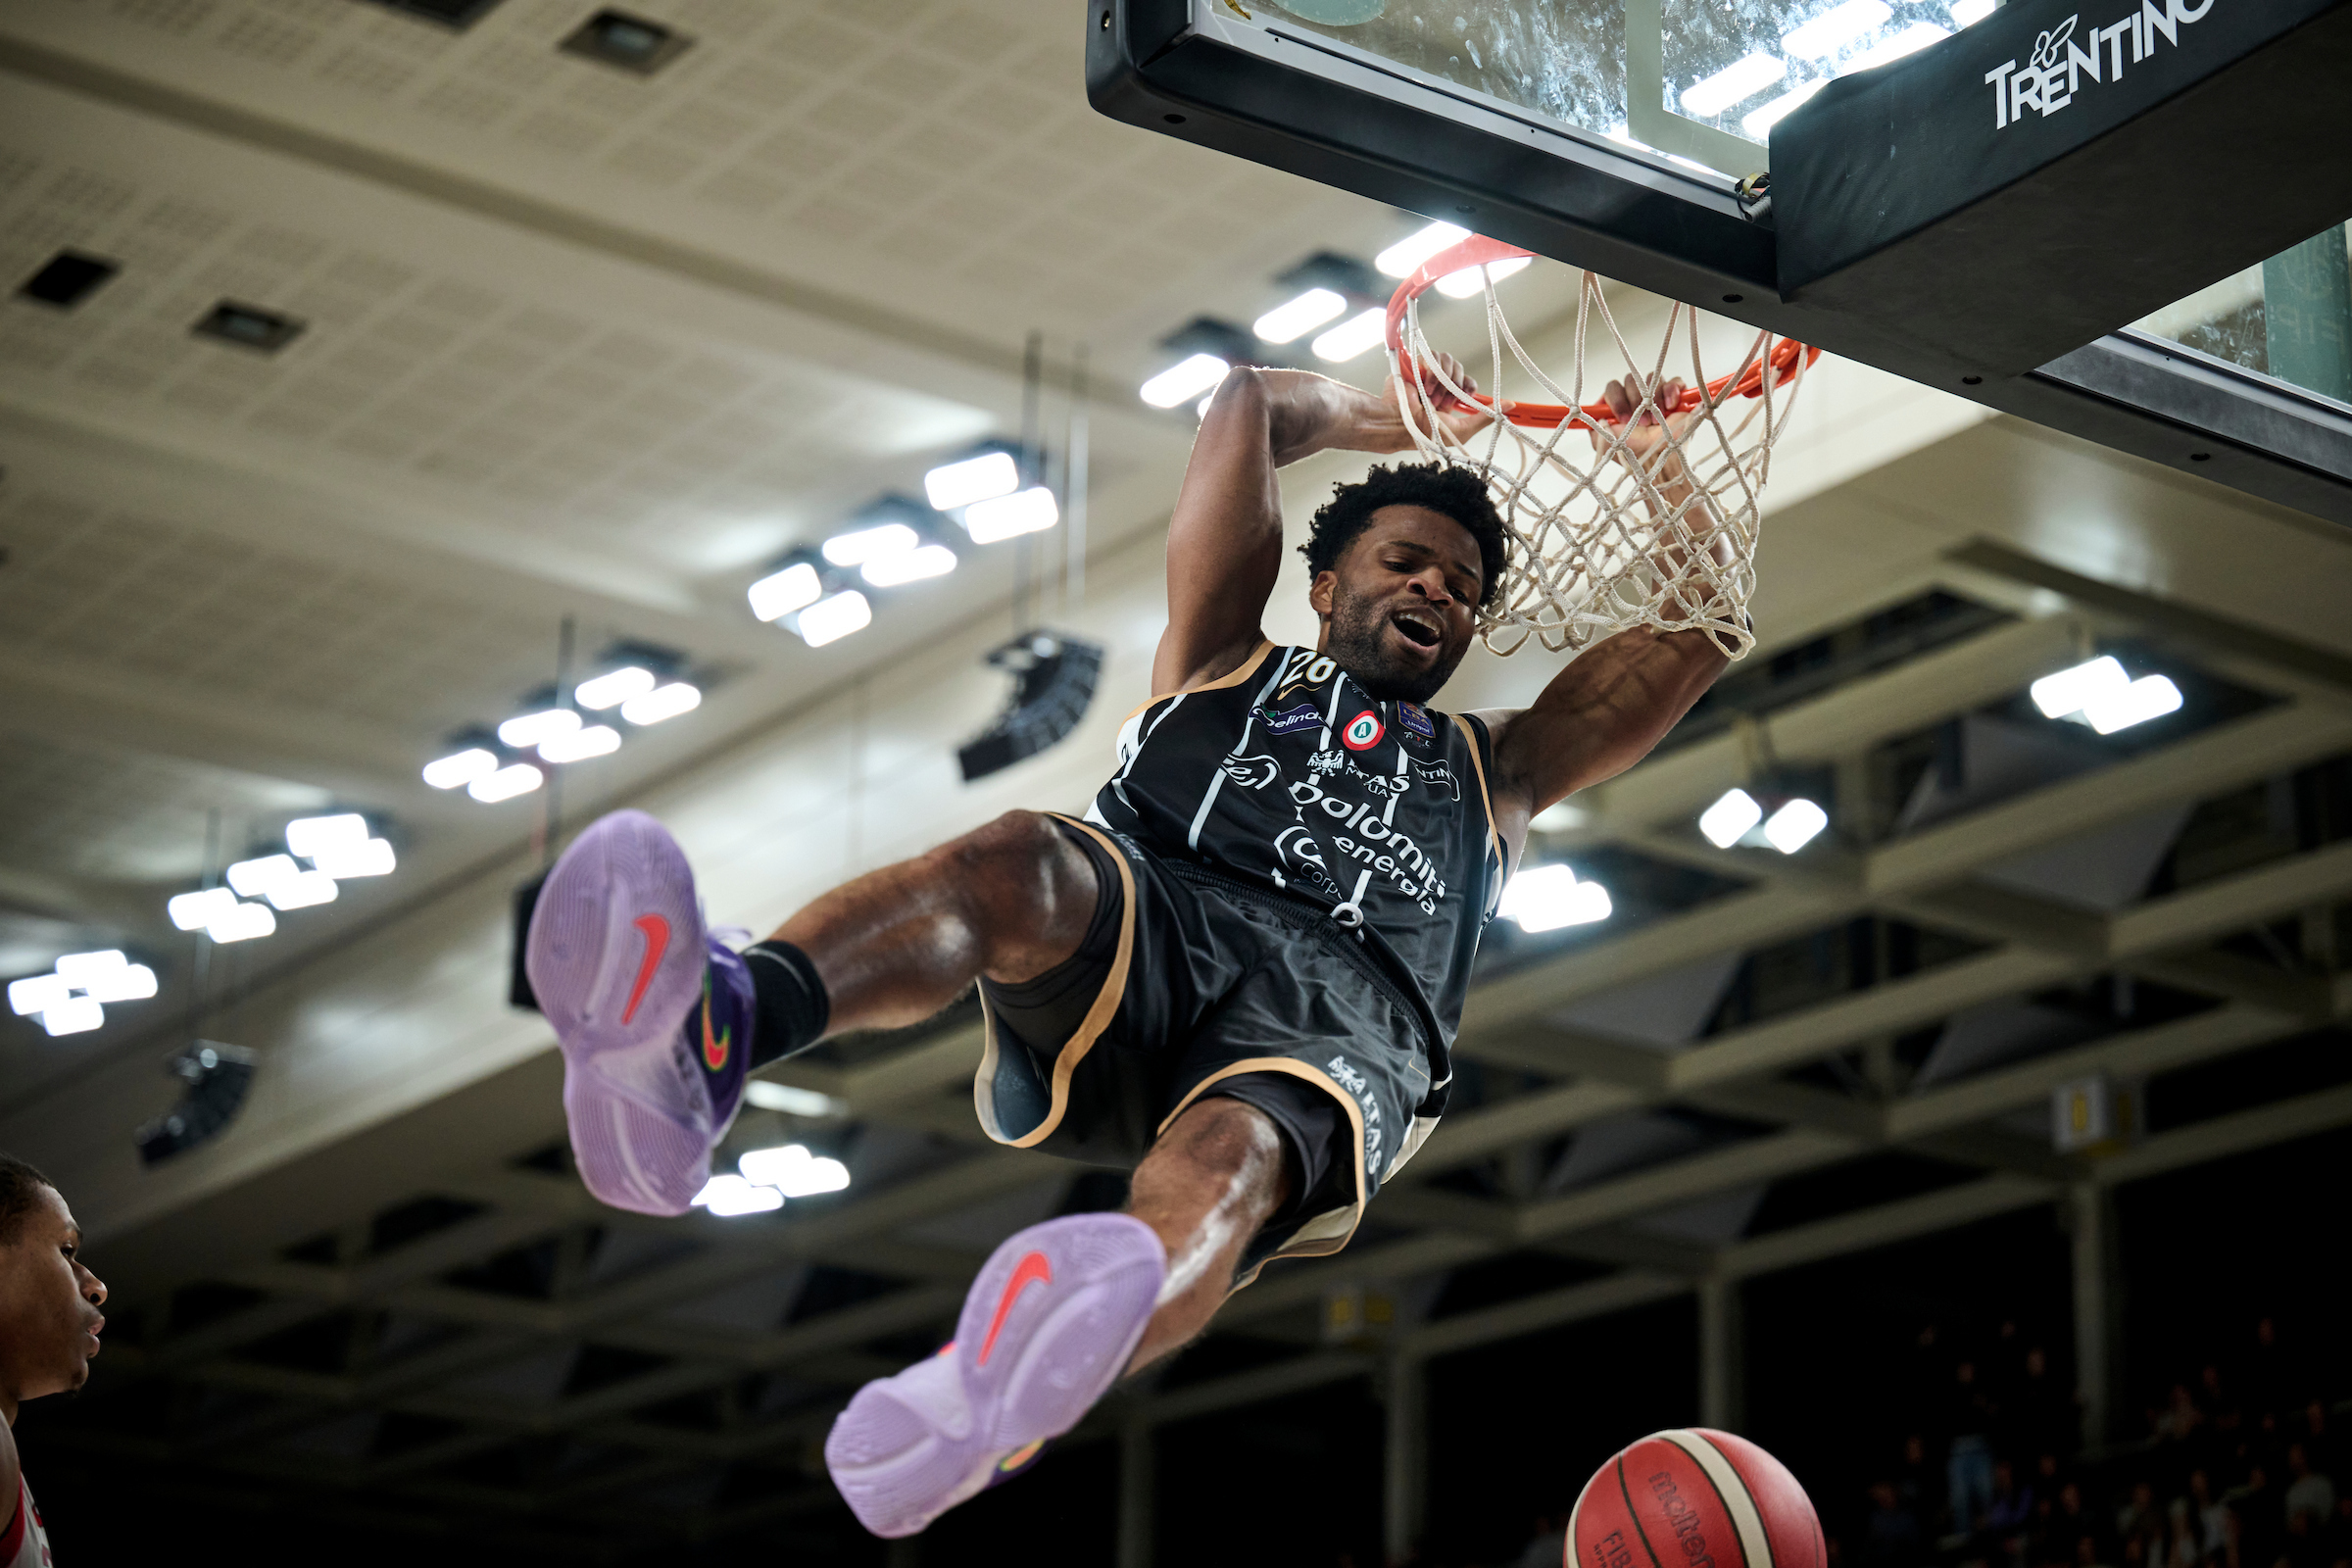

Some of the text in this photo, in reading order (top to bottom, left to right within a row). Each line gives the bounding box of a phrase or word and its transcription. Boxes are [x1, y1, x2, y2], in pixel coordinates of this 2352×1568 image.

[1357, 723, 1369, 737] A
[1332, 835, 1436, 916] energia
[1603, 1530, 1637, 1568] FIB
[1648, 1471, 1716, 1568] molten
